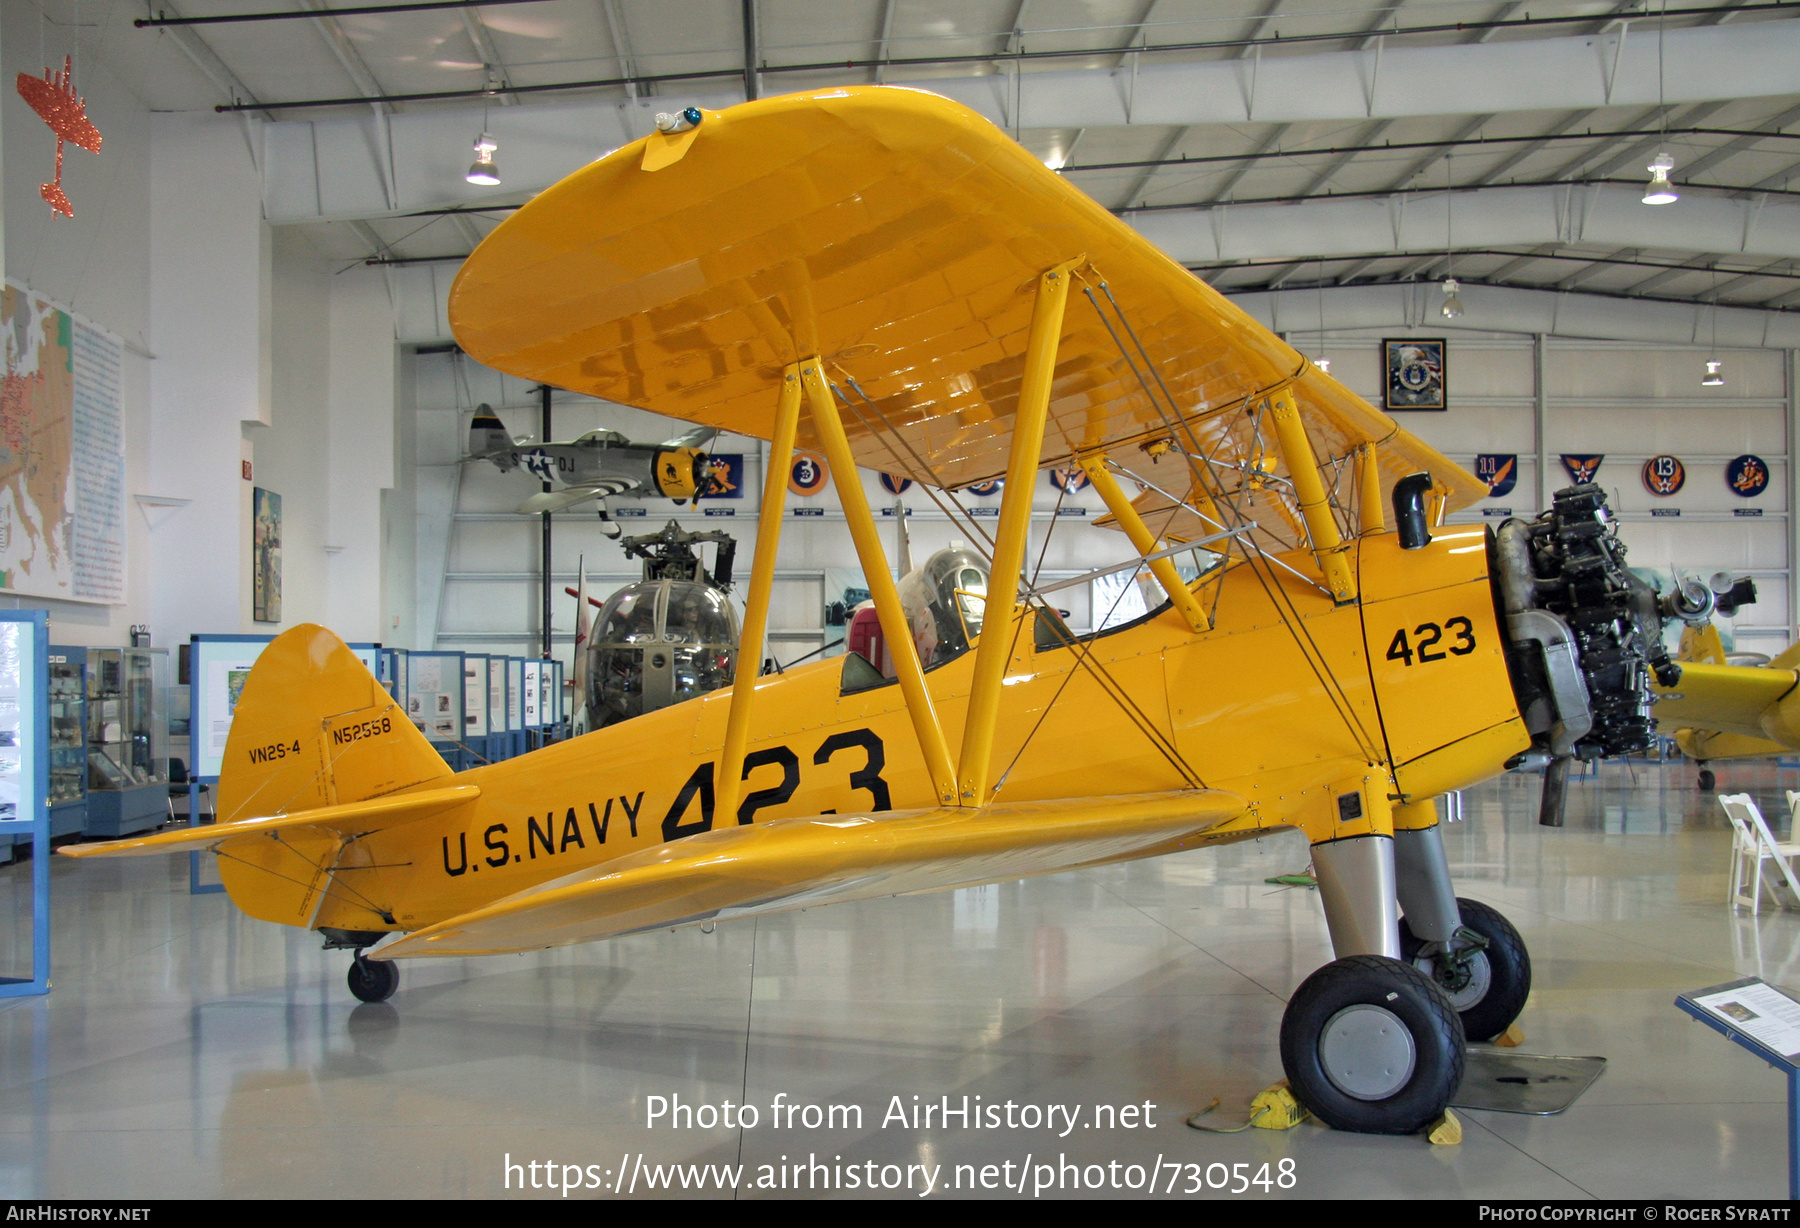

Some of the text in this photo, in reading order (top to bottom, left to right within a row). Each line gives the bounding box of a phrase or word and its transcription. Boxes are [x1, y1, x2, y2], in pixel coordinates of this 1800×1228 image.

[1480, 457, 1496, 474] 11
[1657, 456, 1674, 476] 13
[1386, 615, 1477, 667] 423
[333, 718, 391, 745] N52558
[249, 739, 301, 764] VN2S-4
[660, 727, 892, 844] 423
